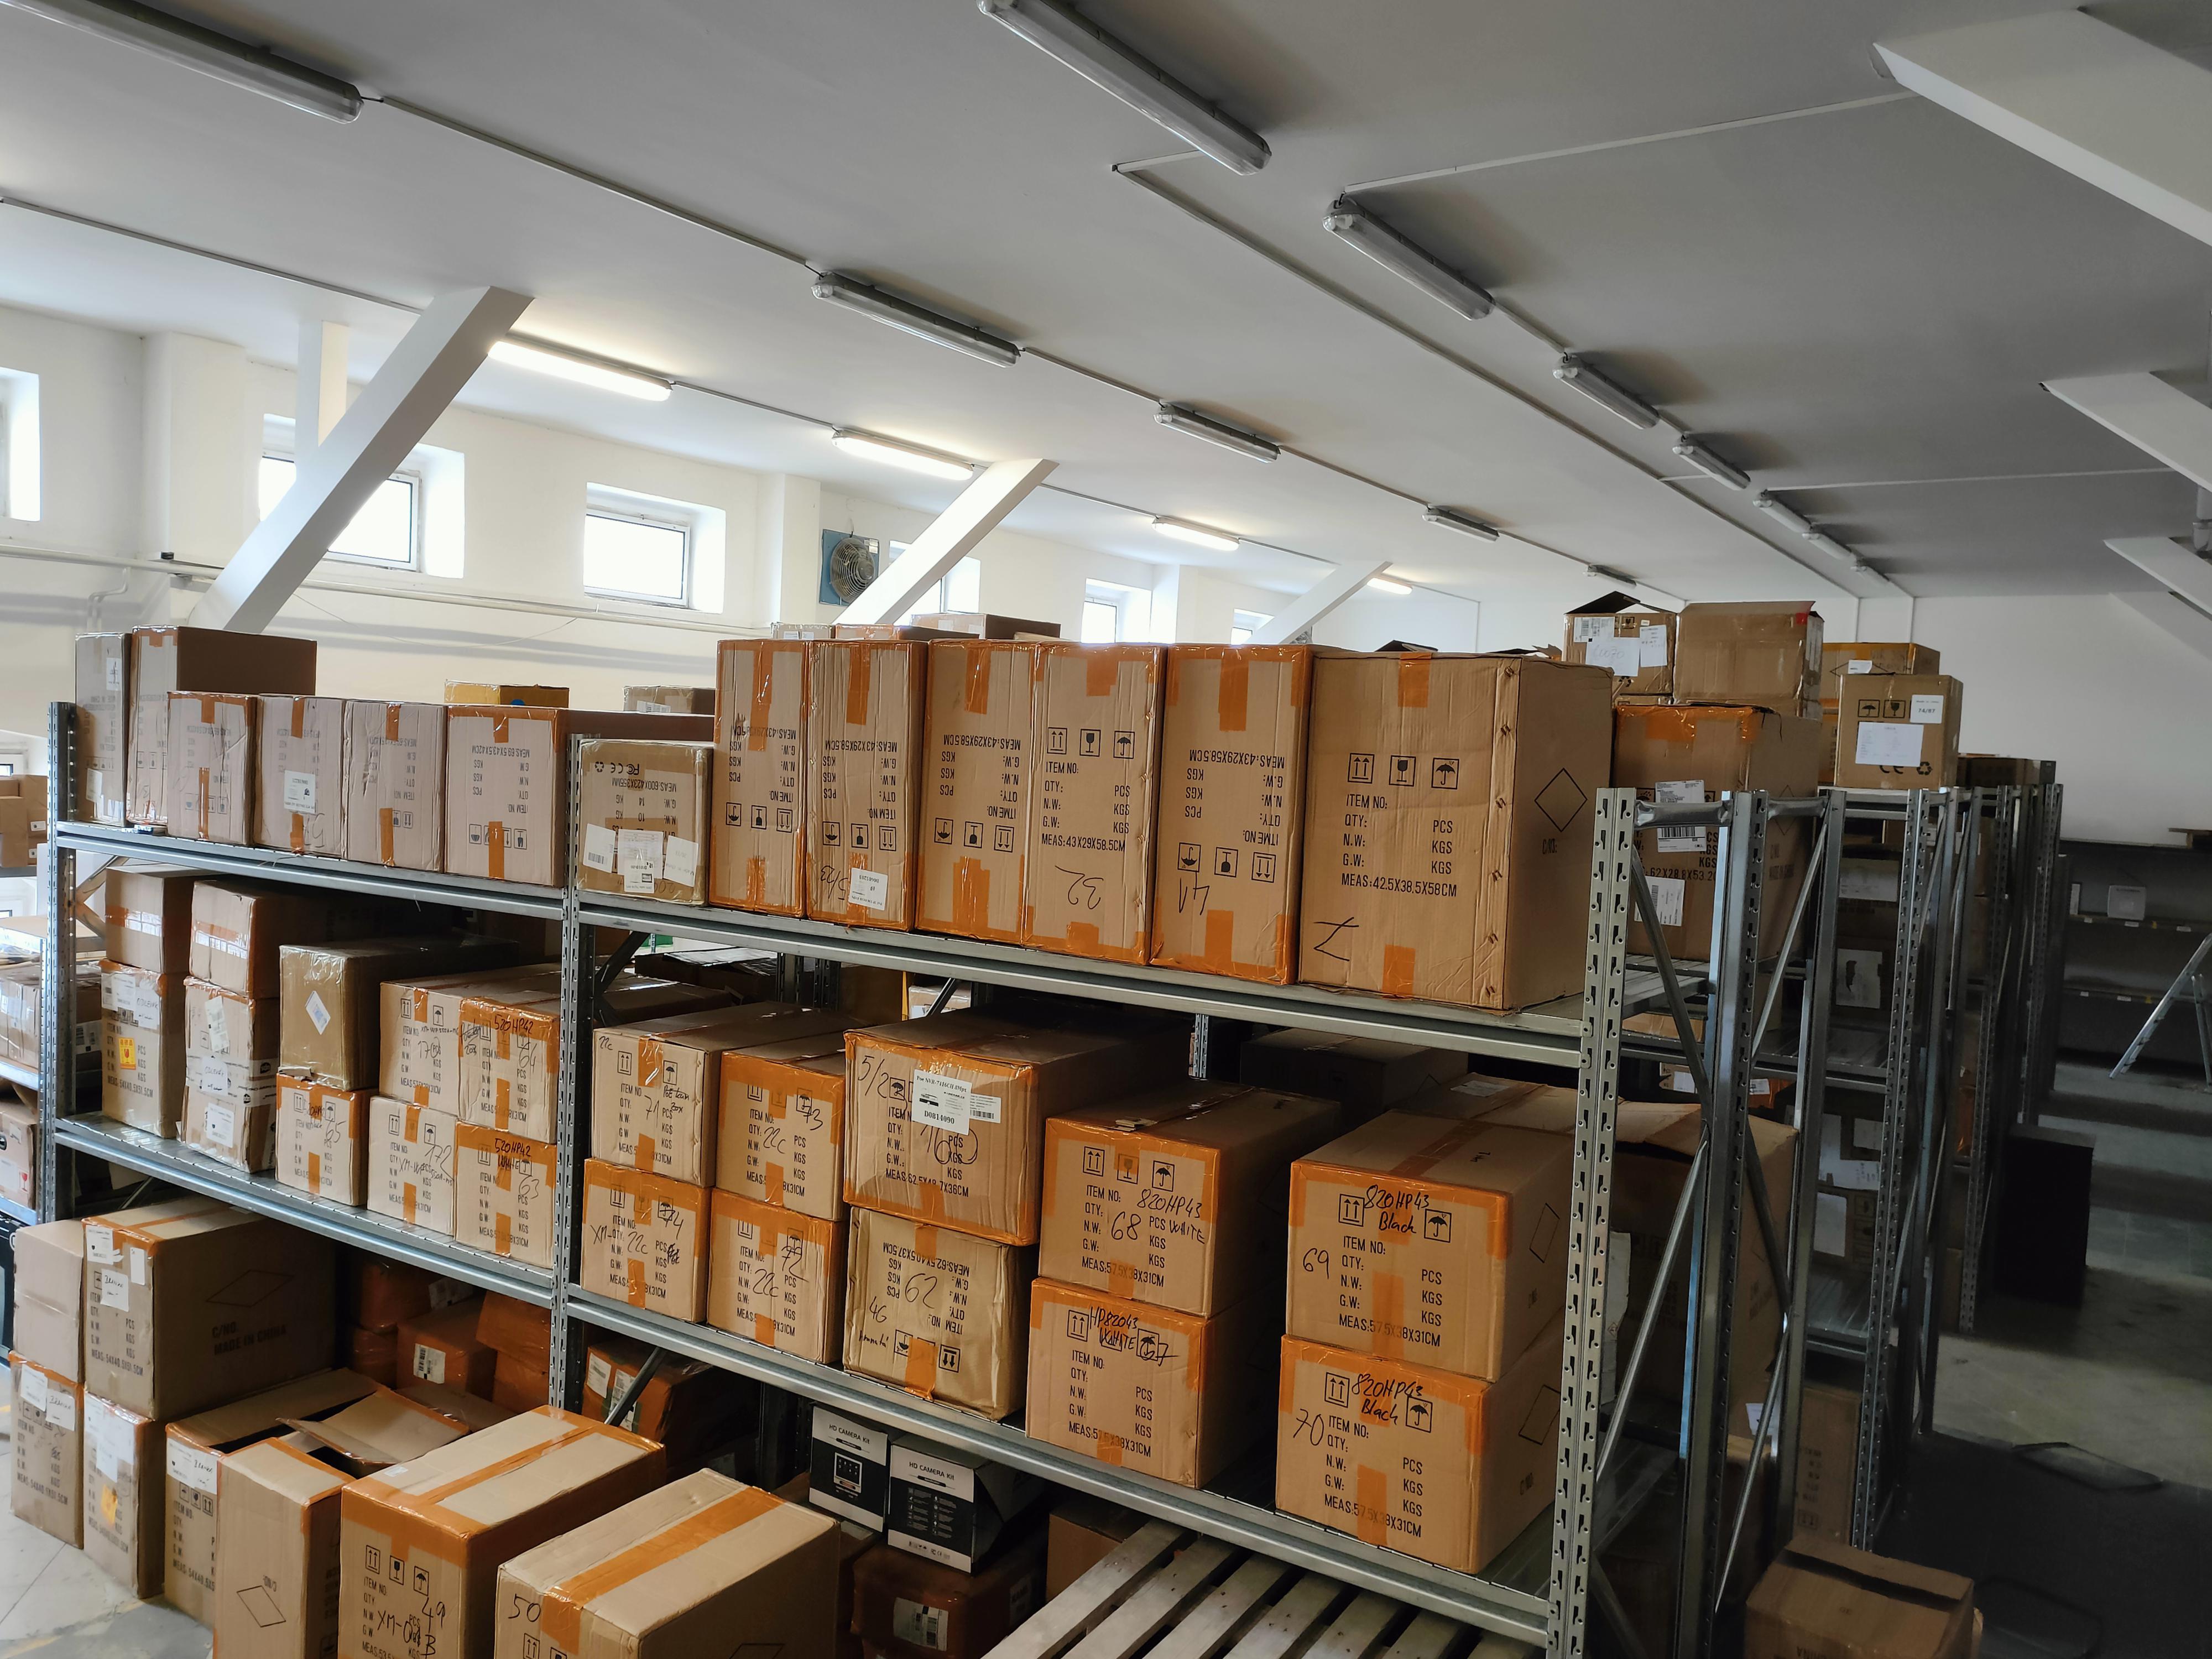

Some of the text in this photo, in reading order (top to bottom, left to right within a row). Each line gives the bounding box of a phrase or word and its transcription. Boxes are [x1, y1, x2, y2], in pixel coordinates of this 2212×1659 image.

[474, 760, 483, 768] KGS
[729, 757, 741, 766] KGS
[823, 757, 836, 766] KGS
[942, 752, 956, 763] KGS
[941, 768, 954, 779] KGS
[1046, 761, 1078, 774] ITEM NO:
[473, 773, 482, 781] KGS
[729, 772, 740, 782] PCS
[823, 773, 836, 782] KGS
[1187, 768, 1203, 781] KGS
[473, 786, 482, 795] PCS
[823, 789, 837, 799] PCS
[940, 785, 1017, 802] QTY: PCS
[1045, 780, 1130, 797] QTY: PCS
[1186, 787, 1203, 800] KGS
[616, 795, 676, 808] G.W: 14 KG
[1044, 799, 1129, 815] N.W: KGS
[1346, 794, 1387, 810] ITEM NO:
[517, 804, 528, 813] ITEM
[879, 809, 896, 820] ITEM
[615, 810, 676, 823] N.W: 10 KG
[1185, 806, 1281, 827] QTY: PCS
[1043, 817, 1129, 833] G.W: KGS
[1345, 813, 1453, 834] QTY: PCS
[1343, 833, 1452, 854] N.W: KGS
[1343, 853, 1452, 875] G.W: KGS
[517, 1069, 526, 1079] PCS
[518, 1084, 526, 1093] KGS
[621, 1083, 633, 1094] ITEM
[518, 1099, 526, 1108] KGS
[662, 1107, 673, 1119] PCS
[749, 1109, 763, 1121] ITEM
[662, 1123, 673, 1134] KGS
[888, 1123, 902, 1135] QTY:
[661, 1138, 672, 1149] KGS
[794, 1135, 806, 1147] PCS
[794, 1152, 806, 1164] KGS
[481, 1172, 491, 1182] ITEM
[794, 1168, 805, 1181] KGS
[947, 1167, 962, 1180] KGS
[518, 1195, 528, 1205] PCS
[1086, 1185, 1121, 1203] ITEM NO:
[519, 1209, 528, 1219] KGS
[1085, 1202, 1166, 1230] QTY: PCS
[613, 1215, 625, 1227] ITEM
[519, 1223, 529, 1233] KGS
[656, 1240, 667, 1253] PCS
[1149, 1236, 1166, 1249] KGS
[1343, 1235, 1386, 1255] ITEM NO:
[740, 1246, 753, 1259] ITEM
[656, 1256, 666, 1268] KGS
[889, 1259, 901, 1270] KGS
[1148, 1254, 1165, 1269] KGS
[1342, 1254, 1442, 1285] QTY: PCS
[655, 1271, 666, 1284] KGS
[785, 1275, 796, 1288] PCS
[888, 1272, 900, 1284] KGS
[785, 1292, 796, 1305] KGS
[887, 1286, 900, 1298] PCS
[1421, 1290, 1443, 1306] KGS
[784, 1308, 795, 1321] KGS
[1421, 1311, 1442, 1327] KGS
[945, 1319, 963, 1335] ITEM
[1072, 1349, 1105, 1369] ITEM NO:
[1071, 1367, 1152, 1401] QTY: PCS
[1135, 1405, 1152, 1420] KGS
[1135, 1423, 1151, 1438] KGS
[1328, 1415, 1369, 1438] ITEM NO:
[838, 1428, 861, 1441] CAMERA
[1327, 1435, 1423, 1475] QTY: PCS
[920, 1465, 945, 1477] CAMERA
[1402, 1478, 1423, 1496] KGS
[1402, 1499, 1422, 1517] KGS
[364, 1577, 377, 1590] ITEM
[508, 1593, 541, 1622] 50
